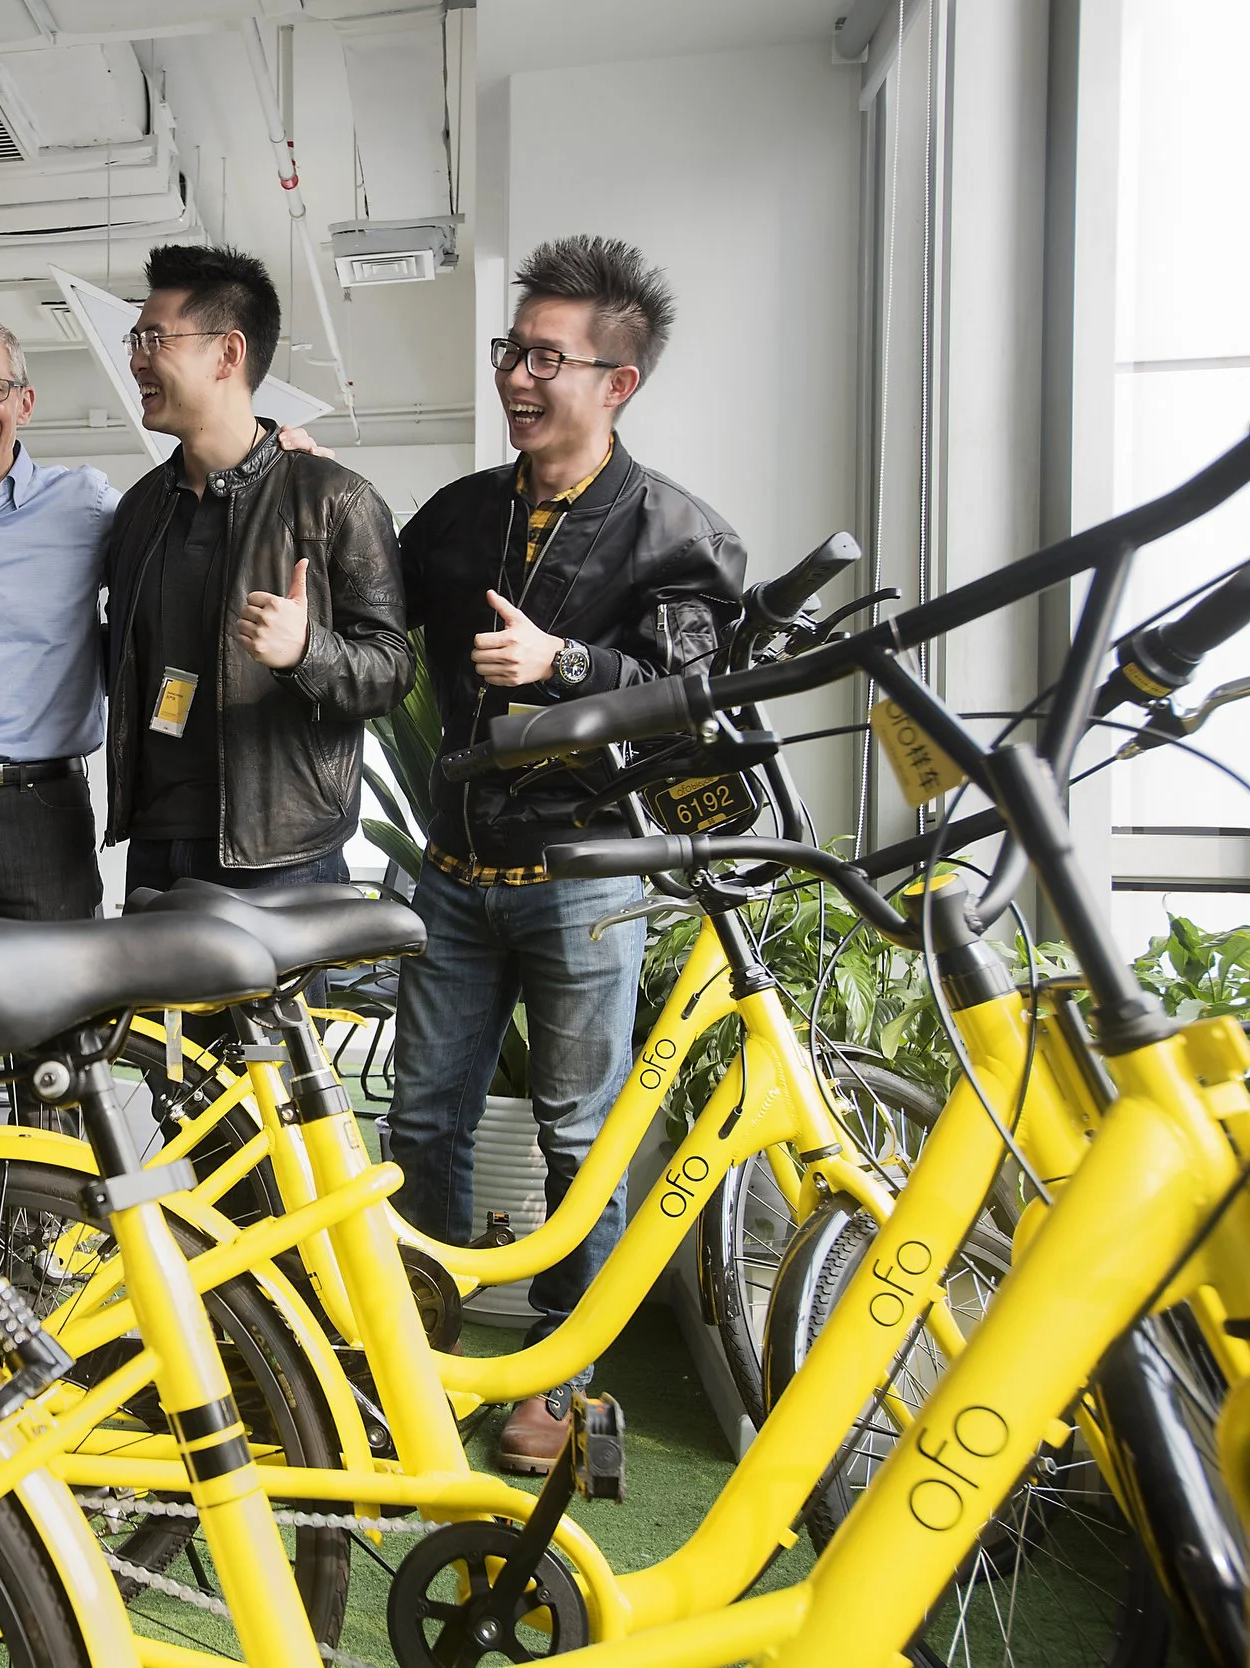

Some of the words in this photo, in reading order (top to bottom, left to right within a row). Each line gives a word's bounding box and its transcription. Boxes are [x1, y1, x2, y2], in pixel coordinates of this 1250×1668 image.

[676, 785, 734, 824] 6192
[639, 1038, 676, 1090] ofo
[660, 1155, 709, 1218] ofo
[869, 1240, 932, 1327] ofo
[908, 1405, 1009, 1532] ofo
